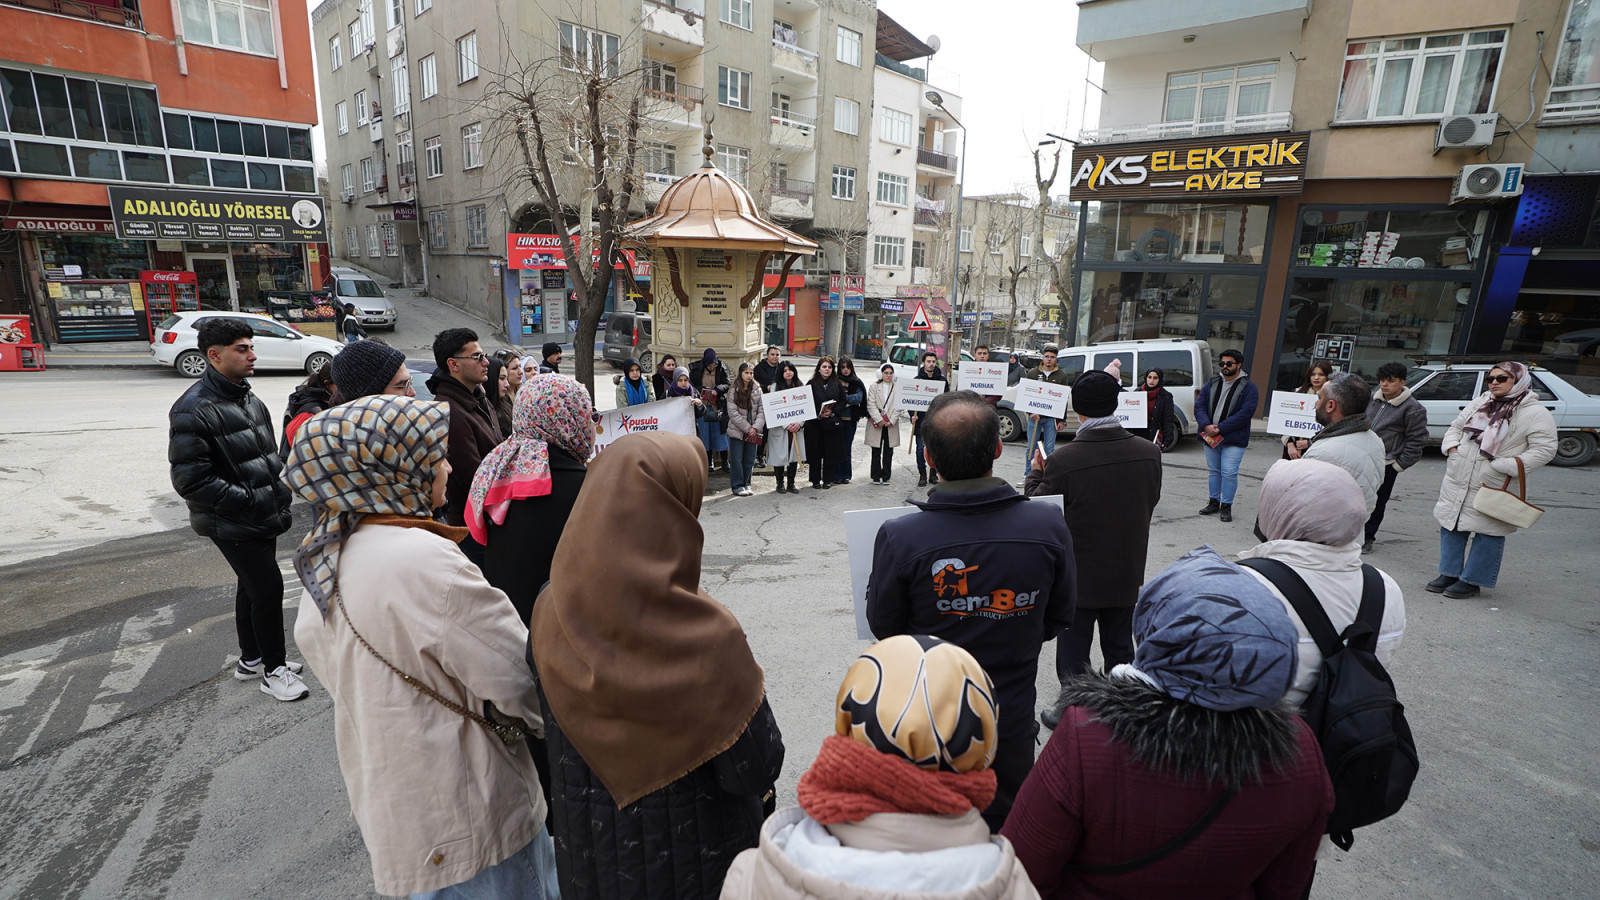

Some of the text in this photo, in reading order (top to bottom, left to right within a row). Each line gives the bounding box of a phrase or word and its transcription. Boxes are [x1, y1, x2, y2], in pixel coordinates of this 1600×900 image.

[1070, 138, 1304, 191] AKS ELEKTRİK
[1184, 169, 1263, 191] AVİZE
[123, 199, 291, 220] ADALIOĞLU YÖRESEL
[16, 221, 96, 231] ADALIOĞLU
[517, 237, 561, 246] HIKVISIO
[153, 273, 180, 281] Coca-Cola
[831, 276, 863, 289] HMAM
[1028, 401, 1053, 410] ANDIRIN
[776, 409, 805, 420] PAZARCIK
[629, 416, 658, 429] pusula
[1285, 420, 1323, 431] ELBİSTAN
[936, 589, 1040, 612] cemBer
